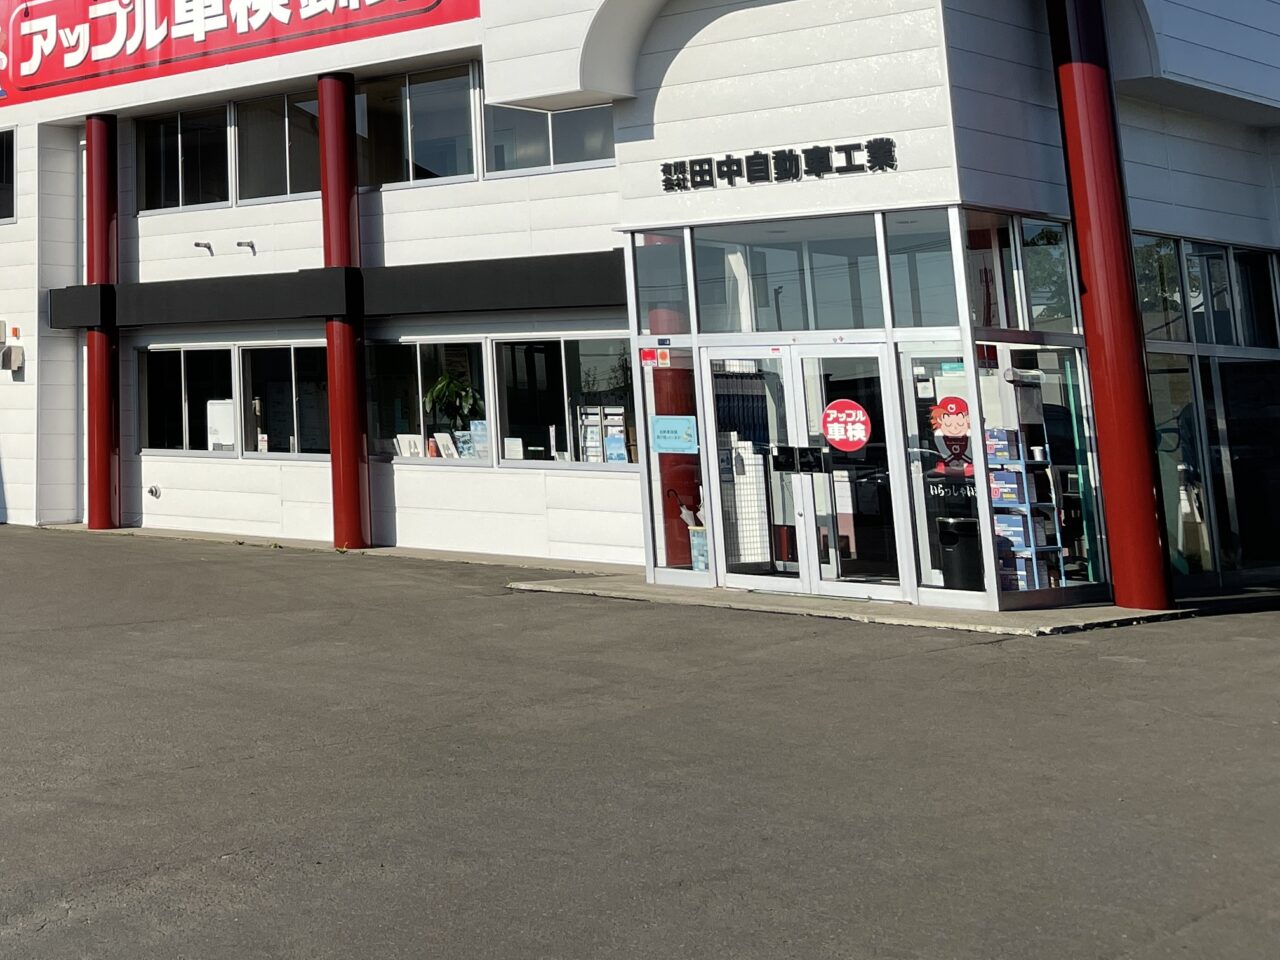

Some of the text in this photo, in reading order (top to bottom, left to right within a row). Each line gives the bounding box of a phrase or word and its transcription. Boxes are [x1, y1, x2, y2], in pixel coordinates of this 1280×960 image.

[826, 410, 866, 422] アップル
[827, 422, 867, 441] 車検
